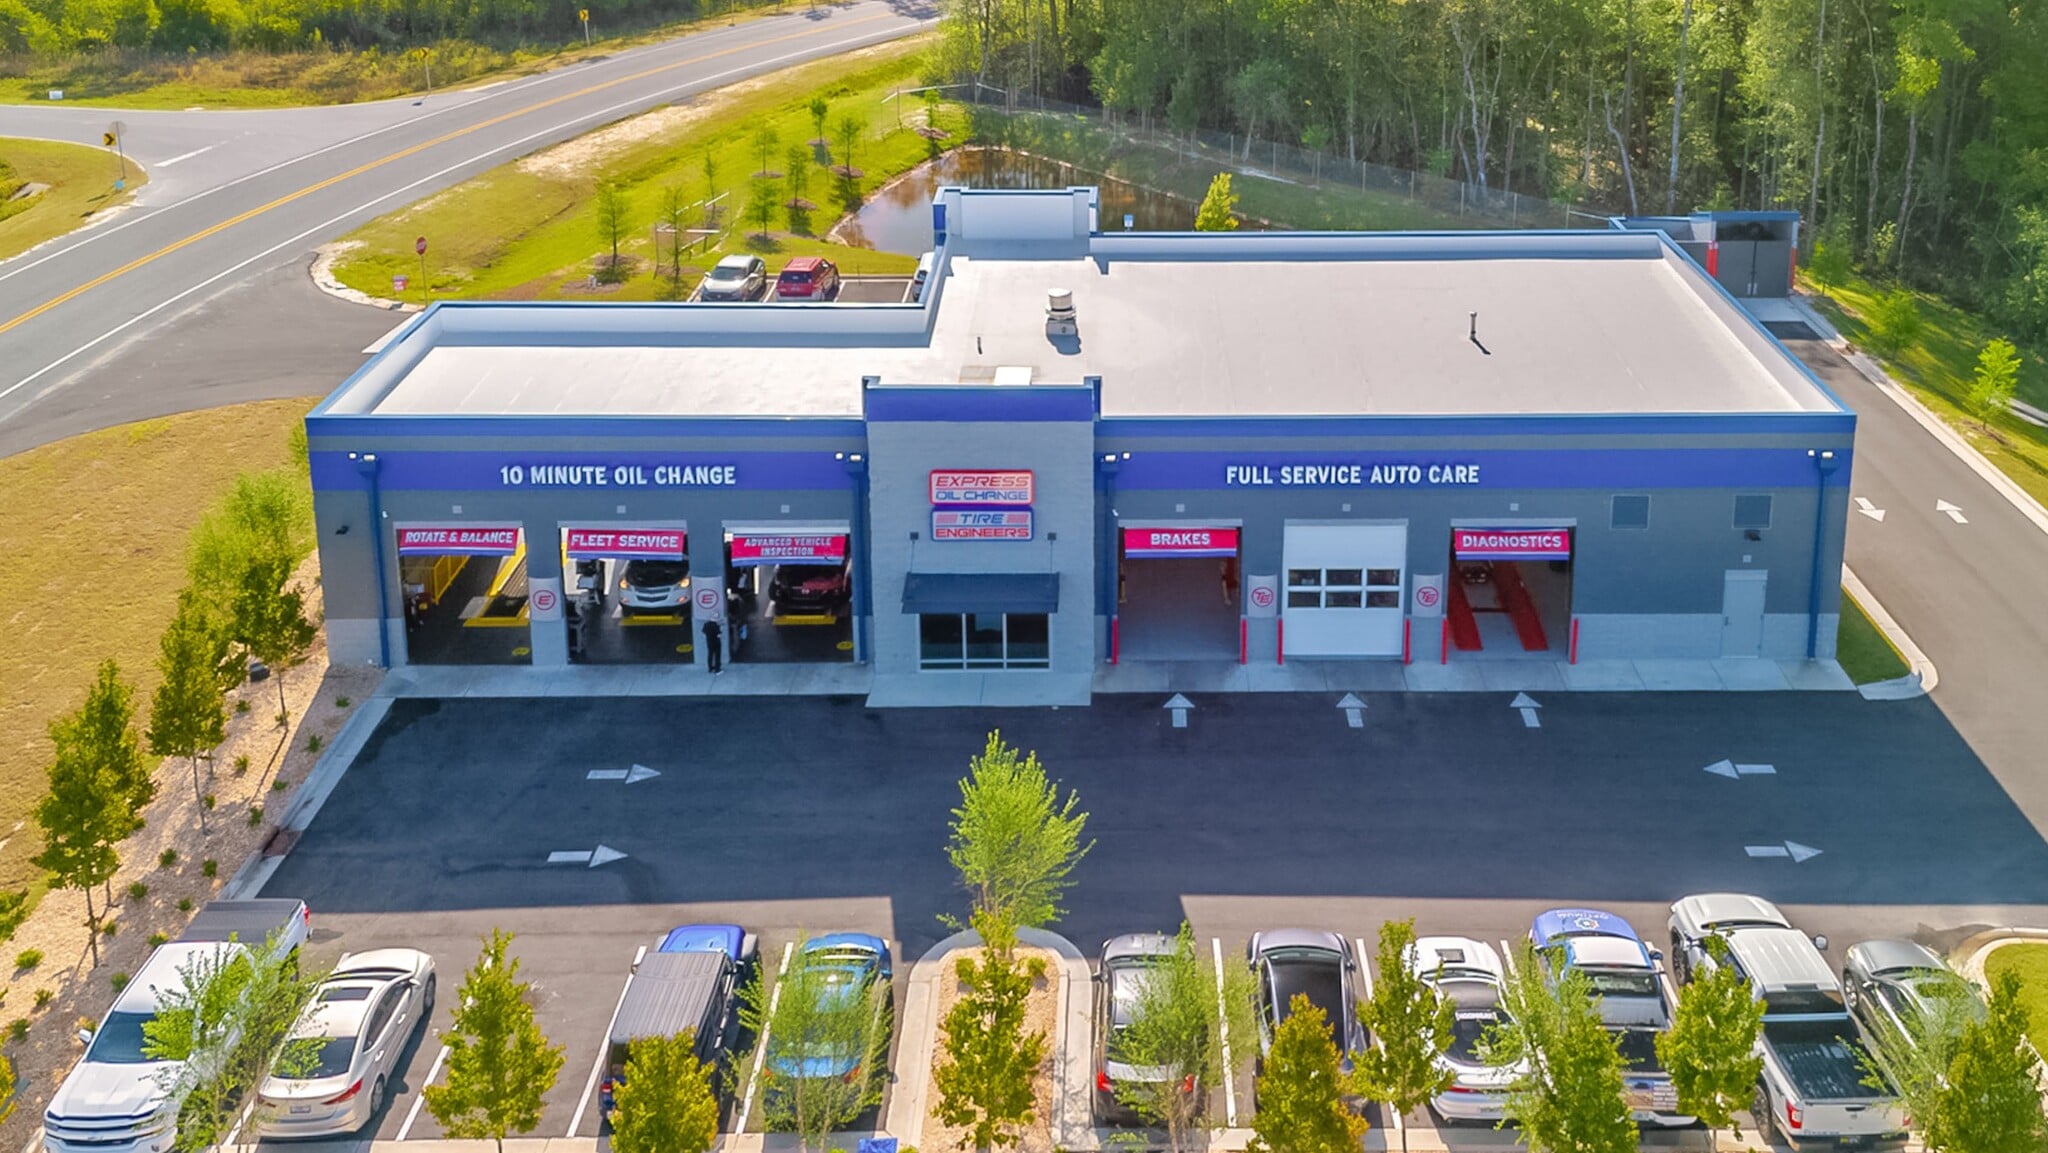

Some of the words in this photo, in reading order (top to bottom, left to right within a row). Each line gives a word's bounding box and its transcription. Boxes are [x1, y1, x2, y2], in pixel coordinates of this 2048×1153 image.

[500, 465, 523, 485] 10
[530, 465, 608, 485] MINUTE
[614, 465, 648, 485] OIL
[654, 465, 737, 485] CHANGE
[935, 475, 1030, 487] EXPRESS
[1226, 465, 1273, 485] FULL
[1280, 465, 1362, 485] SERVICE
[1370, 465, 1422, 484] AUTO
[1428, 465, 1480, 484] CARE
[935, 490, 961, 501] OIL
[963, 490, 1029, 501] CHANGE
[960, 513, 1005, 524] TIRE
[404, 531, 448, 543] ROTATE
[448, 532, 458, 543] &
[460, 532, 514, 545] BALANCE
[935, 528, 1029, 538] ENGINEERS
[1150, 532, 1211, 546] BRAKES
[571, 534, 616, 547] FLEET
[618, 534, 679, 549] SERVICE
[743, 537, 792, 547] ADVANCED
[793, 536, 832, 547] VEHICLE
[1462, 535, 1562, 548] DIAGNOSTICS
[760, 547, 815, 556] INSPECTION
